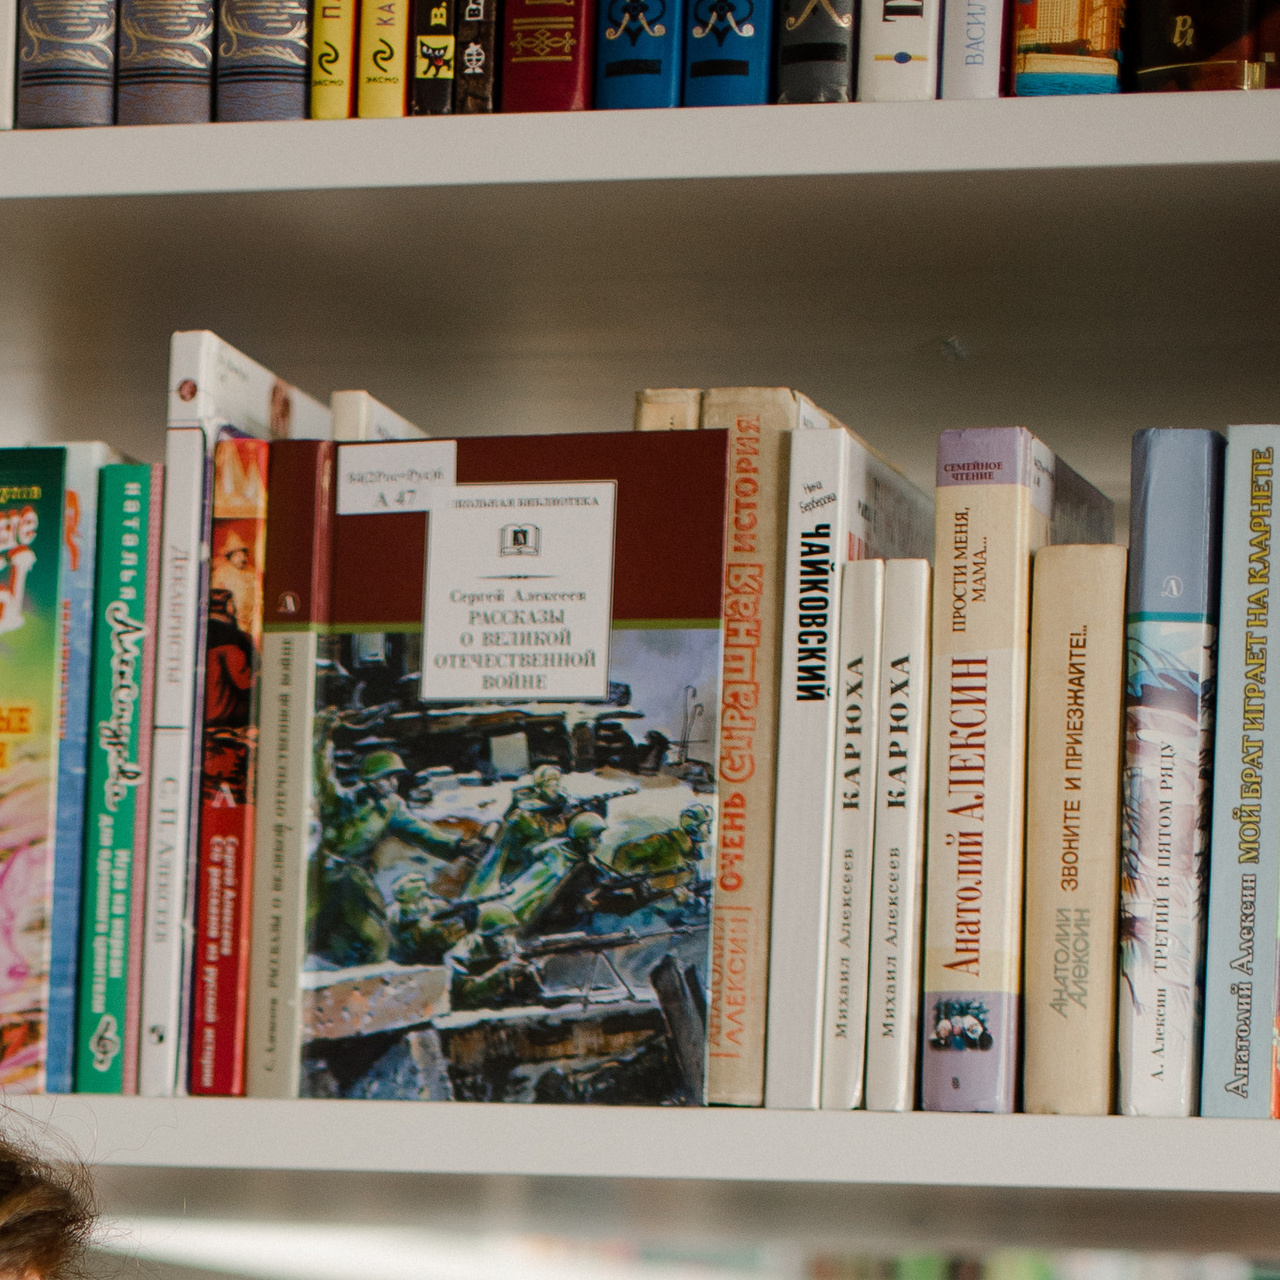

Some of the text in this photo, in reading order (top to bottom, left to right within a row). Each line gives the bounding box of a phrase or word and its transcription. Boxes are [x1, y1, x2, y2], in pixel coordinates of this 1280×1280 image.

[943, 460, 1004, 474] СЕМЕЙНОЕ
[951, 471, 995, 482] ЧТЕНИЕ
[450, 588, 586, 604] Сергей Алексеев
[951, 506, 971, 635] ПРОСТИ МЕНЯ,
[971, 536, 988, 603] МАМА...
[460, 628, 571, 647] О ВЕЛИКОЙ
[468, 608, 565, 626] РАССКАЗЫ
[796, 523, 836, 702] ЧАЙКОВСКИЙ
[433, 651, 596, 669] ОТЕЧЕСТВЕННОЙ
[482, 672, 548, 690] ВОЙНЕ
[719, 414, 761, 893] ОЧЕНЬ ИСТОРИЯ
[841, 656, 865, 811] КАРЮХА
[886, 653, 911, 810] КАРЮХА
[1160, 739, 1177, 791] РЯДУ
[1225, 446, 1274, 1099] Анатолий Алексин МОЙ БРАТ ИГРАЕТ НА КЛАРНЕТЕ
[942, 656, 990, 977] Анатолий АЛЕКСИН
[1061, 776, 1081, 892] ЗВОНИТЕ И
[1157, 799, 1173, 868] ПЯТОМ
[1157, 875, 1170, 888] В
[833, 847, 855, 1040] Михаил Алексеев
[879, 846, 901, 1040] Михаил Алексеев
[1152, 896, 1169, 975] ТРЕТИЙ
[1150, 987, 1167, 1059] Алексин
